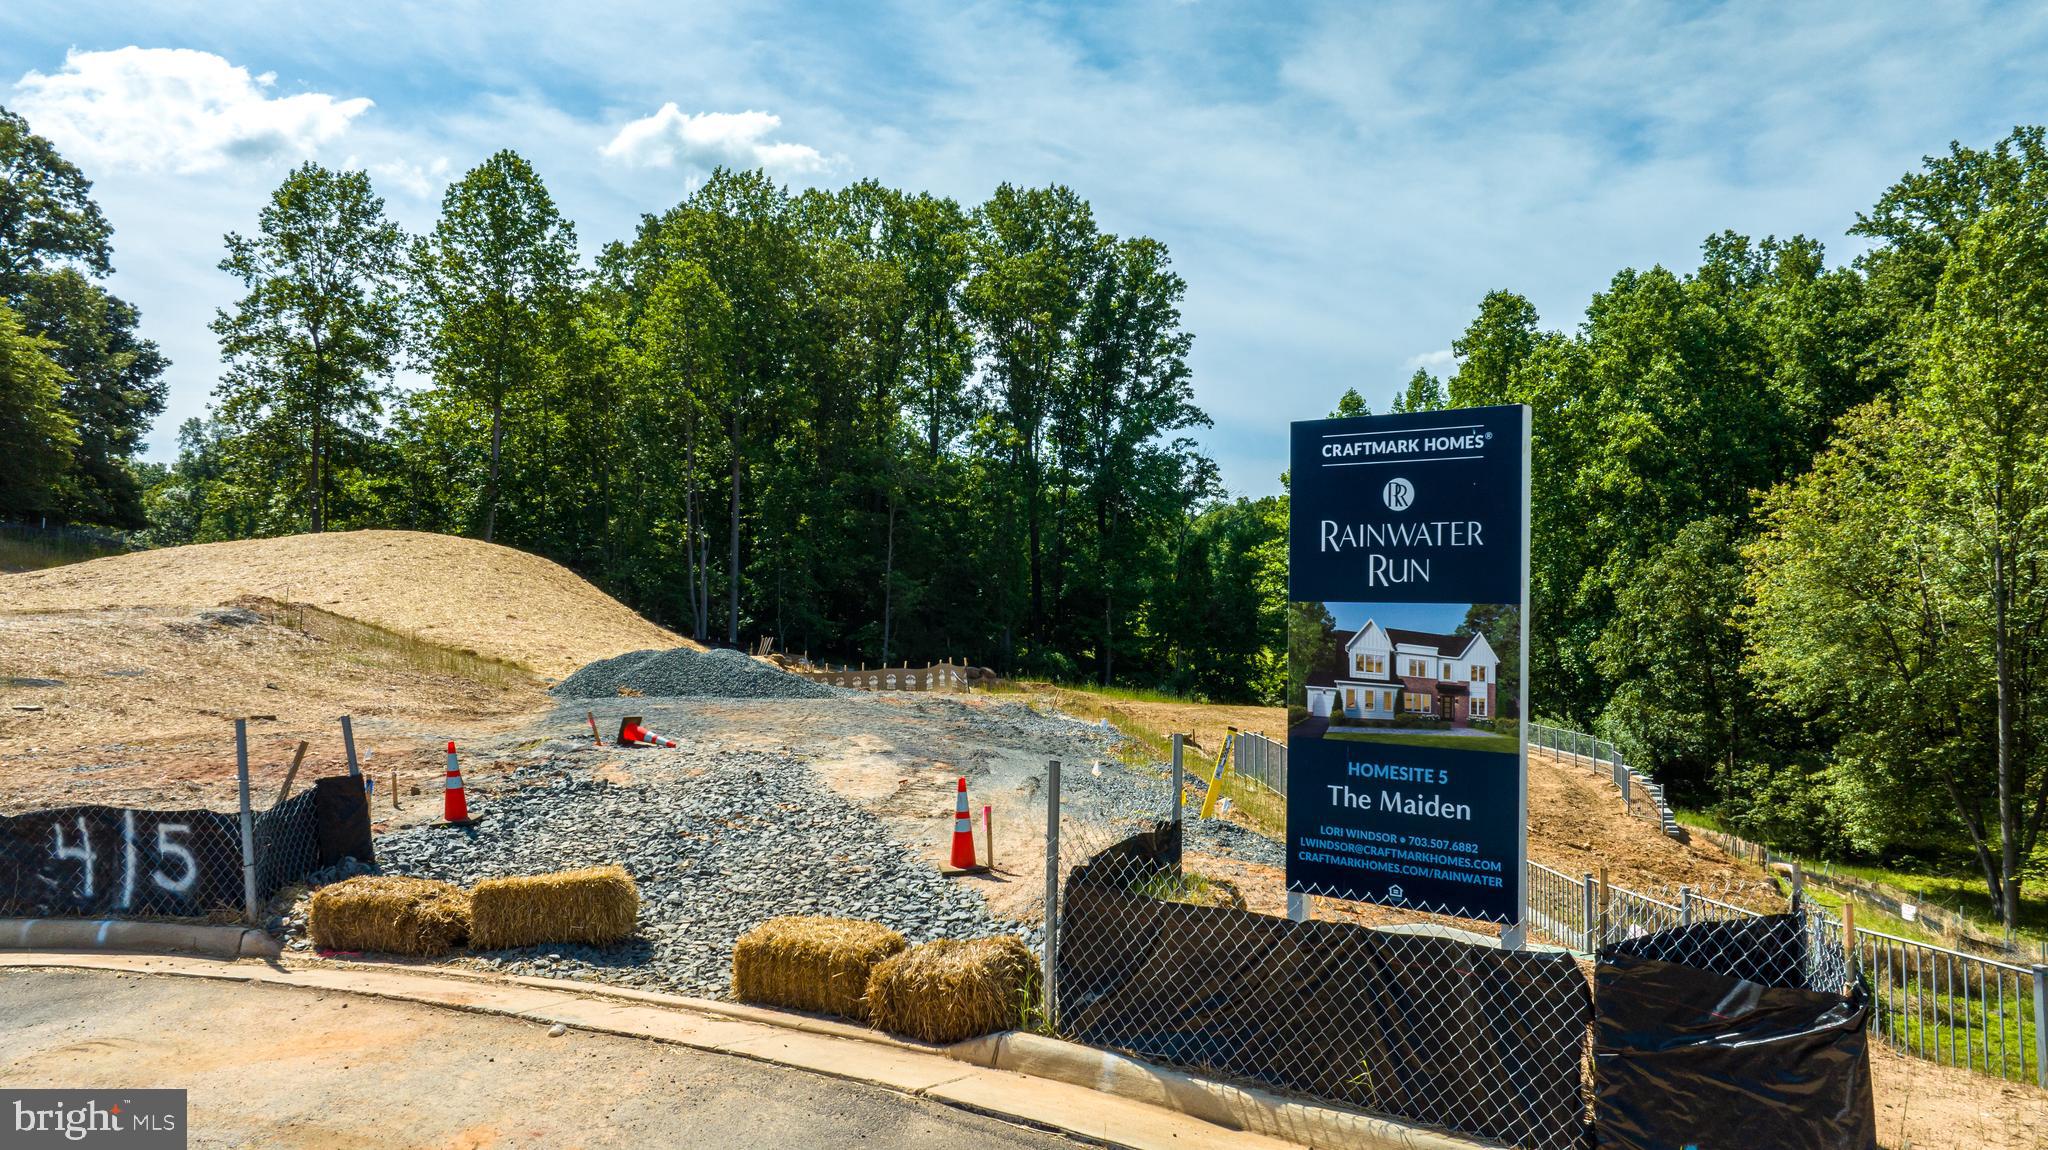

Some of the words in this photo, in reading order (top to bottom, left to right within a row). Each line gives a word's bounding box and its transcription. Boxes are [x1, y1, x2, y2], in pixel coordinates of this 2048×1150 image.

[1322, 438, 1420, 458] CRAFTMARK
[1320, 520, 1484, 552] RAINWATER
[1368, 554, 1430, 587] RUN
[1348, 761, 1434, 784] HOMESITE
[1438, 769, 1449, 785] 5
[1327, 784, 1372, 810] The
[1379, 790, 1472, 821] Maiden
[1300, 837, 1502, 872] LWINDSOR@CRAFTMARKHOMES.COM
[1320, 825, 1344, 837] LORI
[1345, 828, 1398, 844] WINDSOR
[1408, 835, 1479, 854] 703.507.6882
[1298, 851, 1504, 888] CRAFTMARKHOMES.COM/RAINWATER
